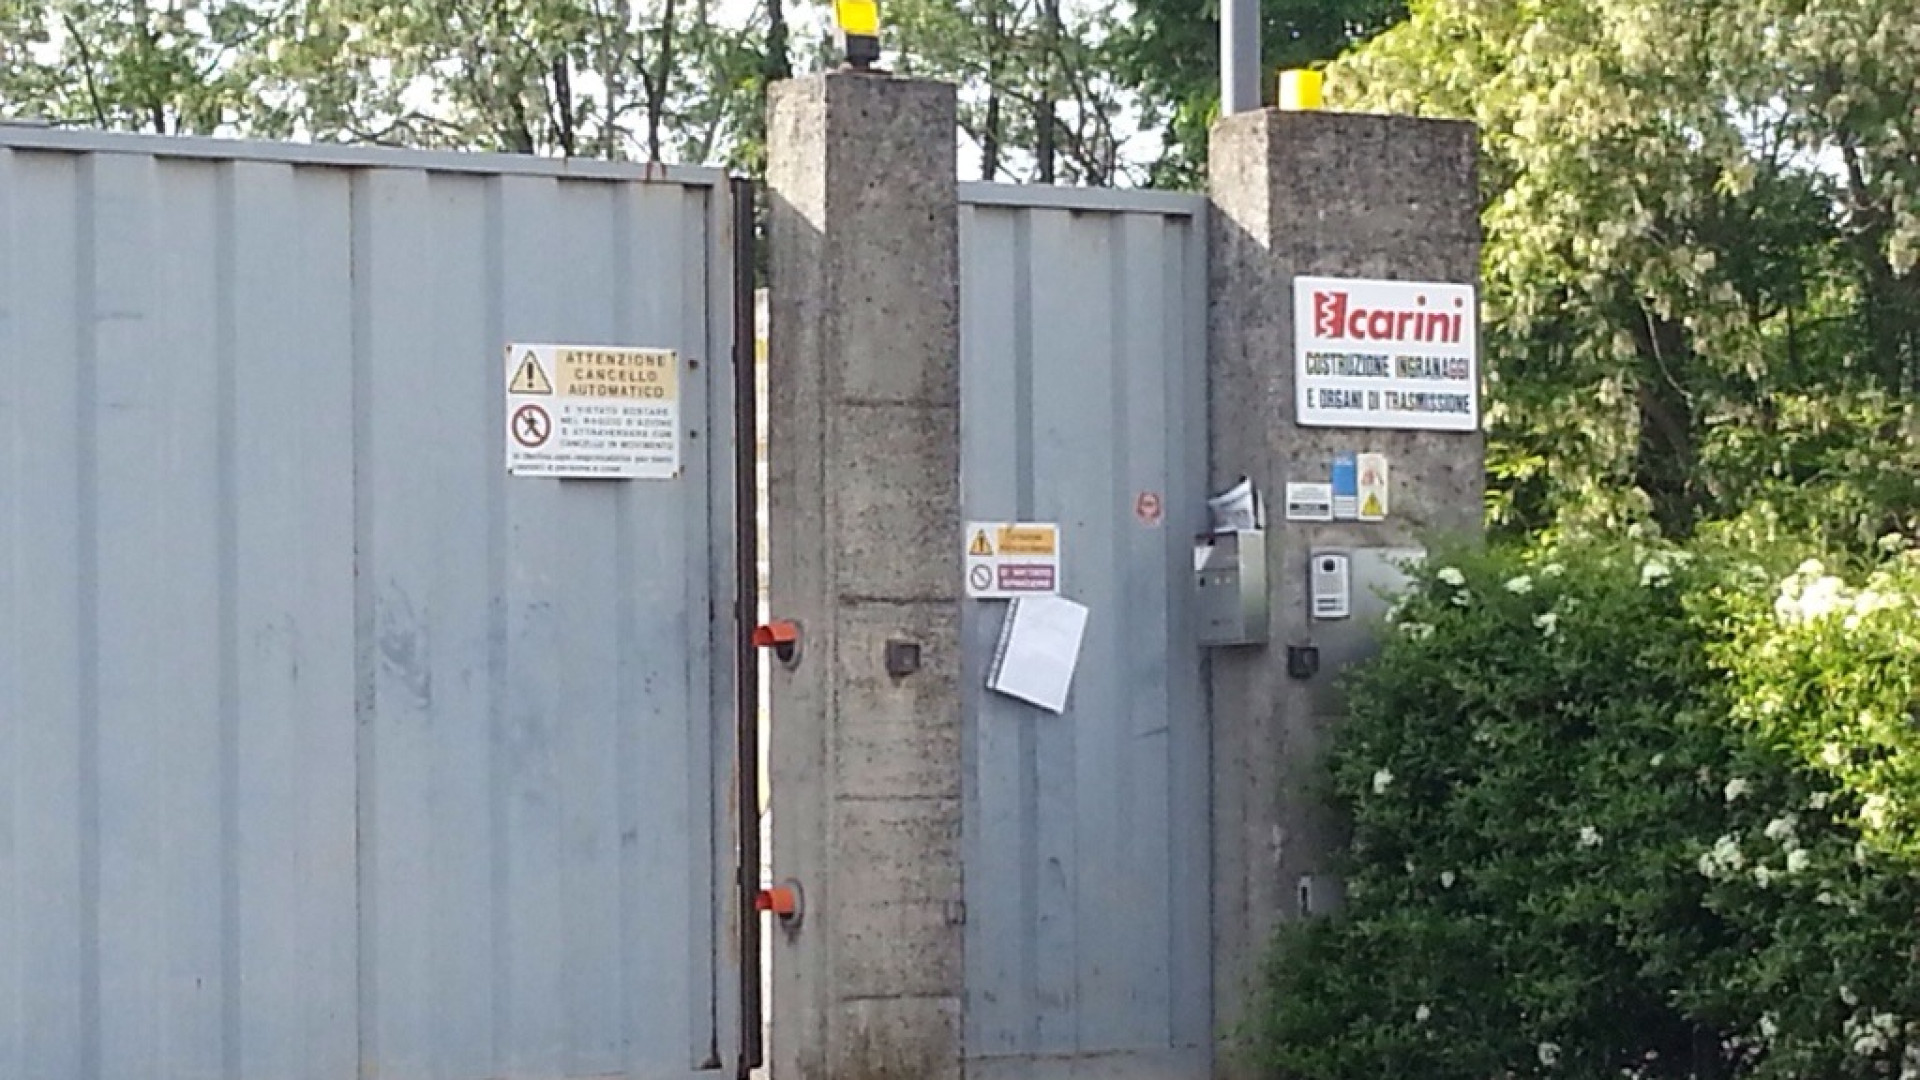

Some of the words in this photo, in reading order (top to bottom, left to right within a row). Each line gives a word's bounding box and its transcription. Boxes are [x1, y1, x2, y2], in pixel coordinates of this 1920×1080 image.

[566, 351, 666, 367] ATTENZIONE
[1305, 351, 1390, 377] COSTRUZIONE
[1395, 355, 1469, 380] INGRANAGGI
[574, 369, 658, 382] CANCELLO
[569, 384, 665, 398] AUTOMATICO
[1307, 388, 1315, 408] E
[1319, 388, 1363, 409] ORGANI
[1368, 390, 1380, 411] DI
[1384, 391, 1470, 414] TRASMISSIONE
